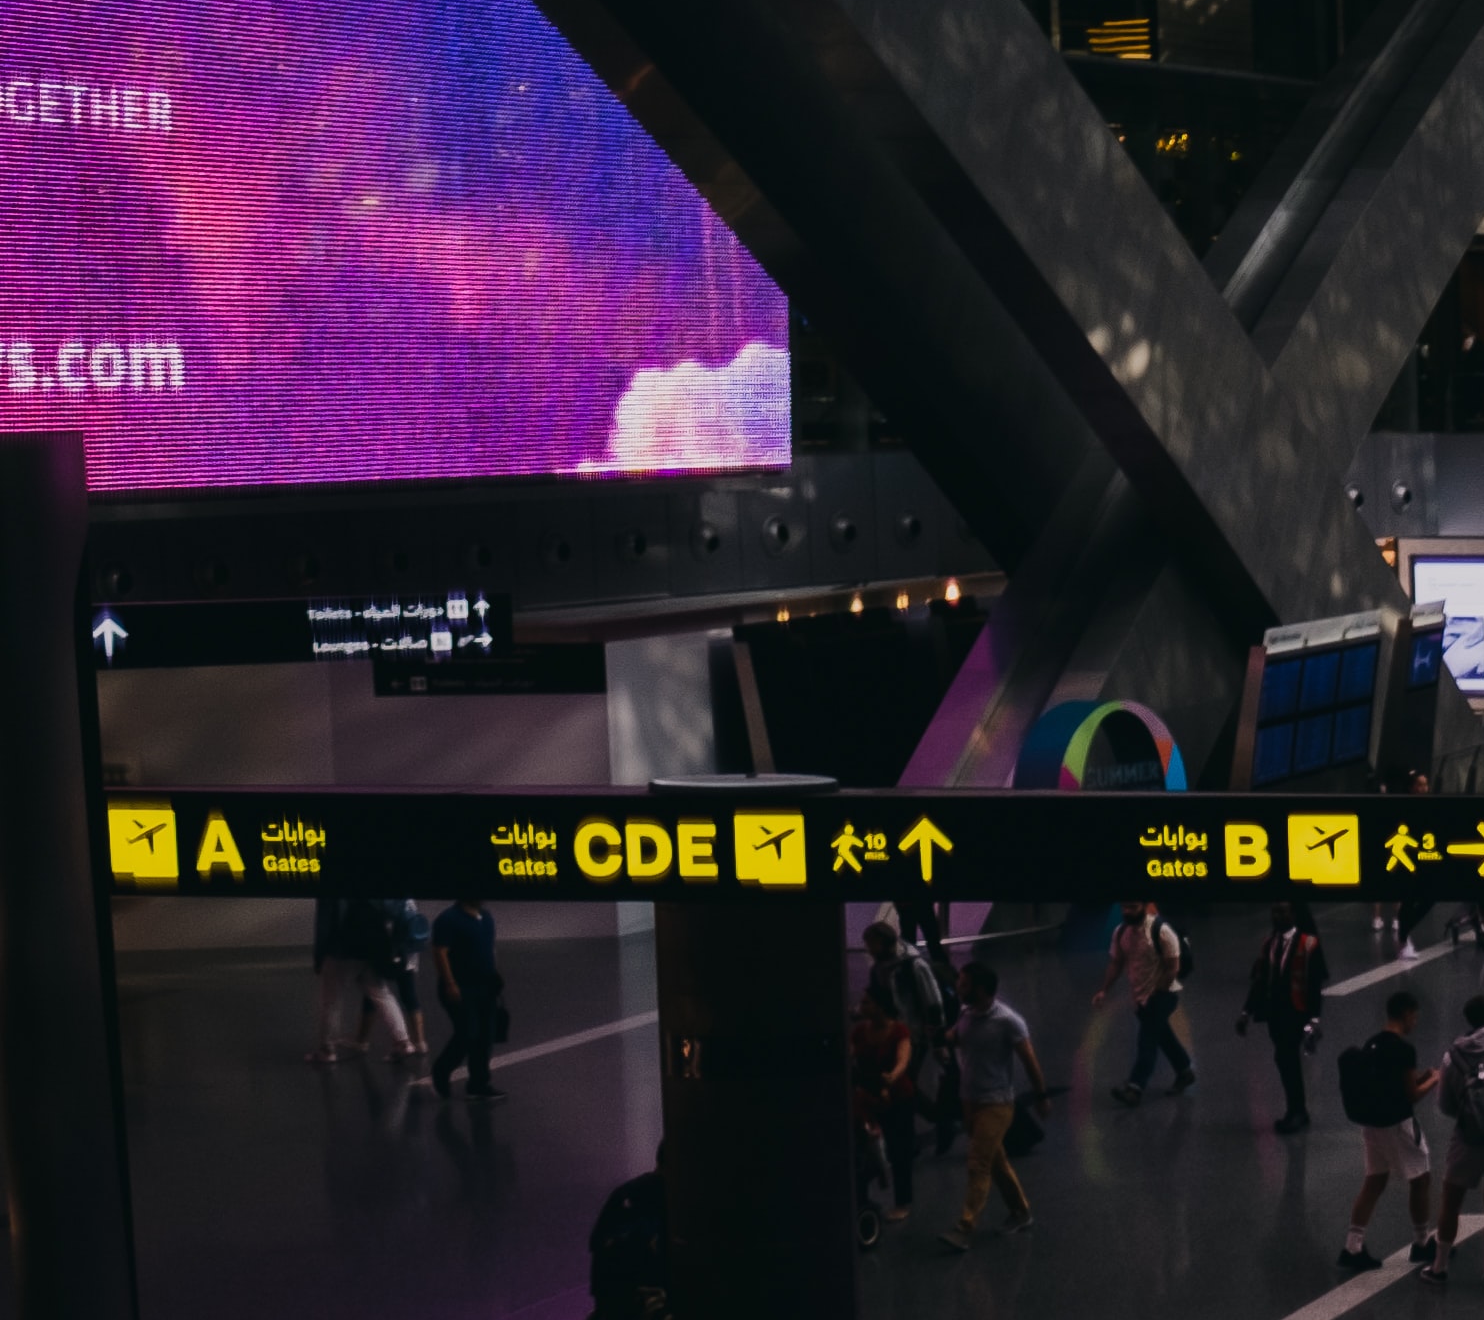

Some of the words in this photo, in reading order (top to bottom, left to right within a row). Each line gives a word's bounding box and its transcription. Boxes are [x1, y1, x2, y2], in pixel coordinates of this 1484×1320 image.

[0, 79, 172, 131] GETHER
[0, 341, 186, 393] s.com
[197, 820, 243, 871] A
[261, 820, 326, 847] بوابات
[491, 823, 556, 849] بوابات
[863, 833, 886, 850] 10
[1140, 825, 1207, 851] بوابات
[575, 823, 717, 876] CDE
[1225, 825, 1270, 876] B
[263, 855, 320, 872] Gates
[499, 858, 557, 876] Gates
[1147, 860, 1208, 877] Gates
